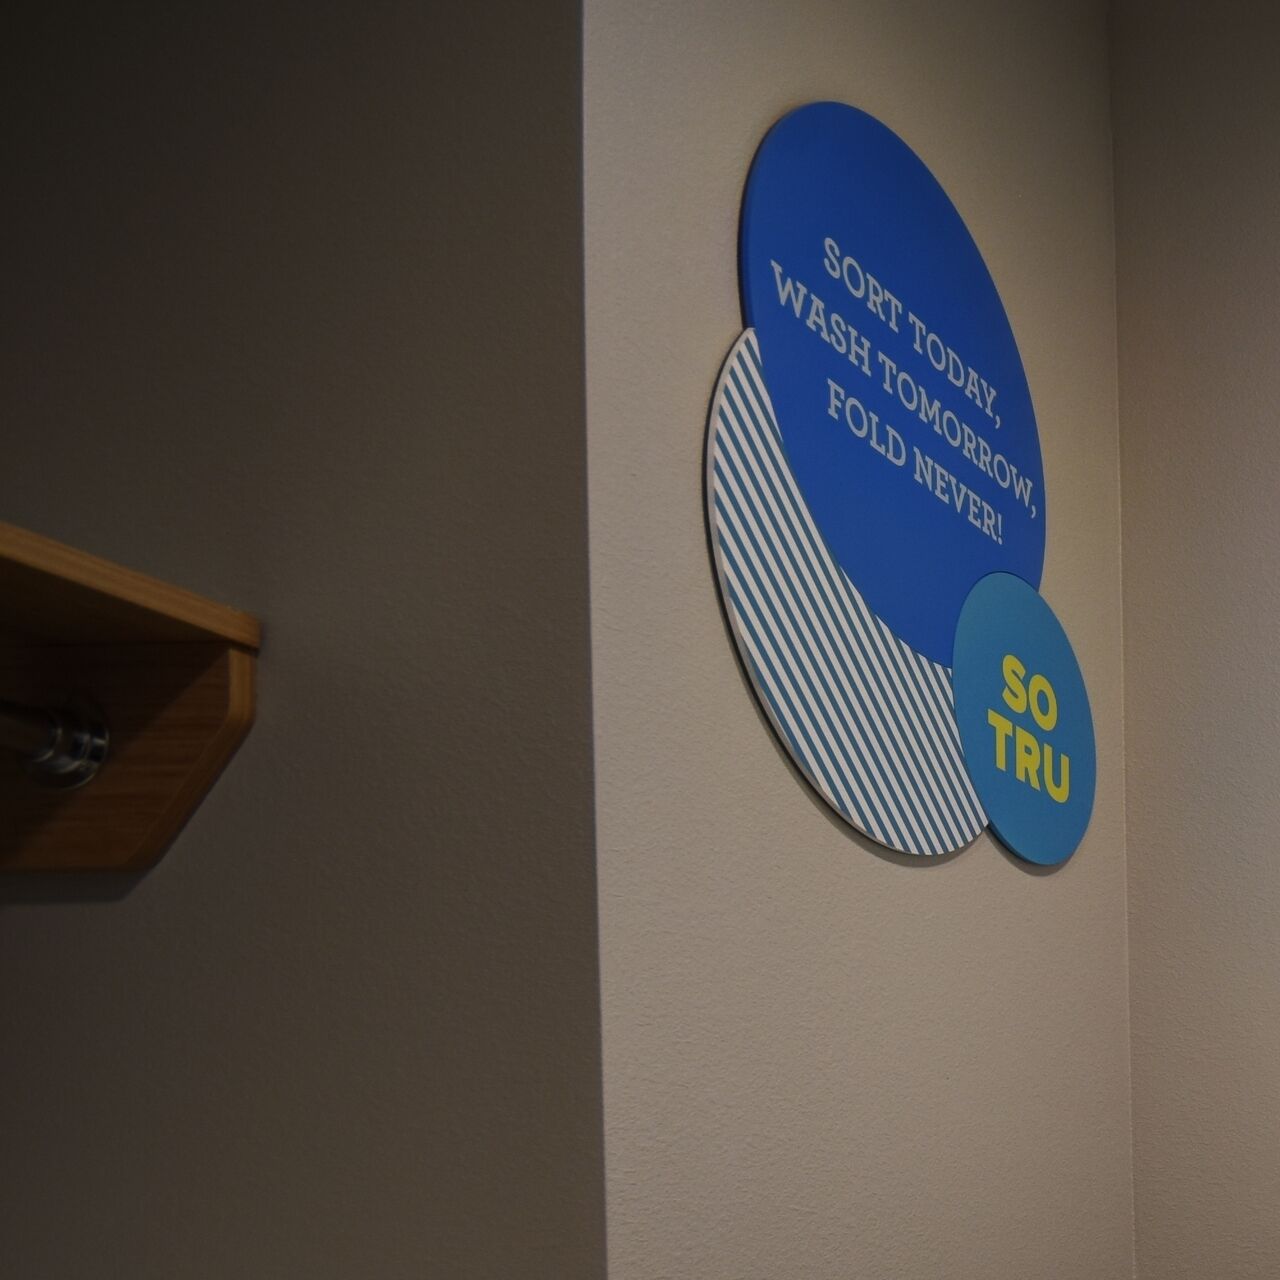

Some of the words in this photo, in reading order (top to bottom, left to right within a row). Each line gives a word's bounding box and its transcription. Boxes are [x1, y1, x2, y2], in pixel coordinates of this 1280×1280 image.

[770, 260, 872, 377] WASH
[878, 349, 1038, 520] TOMORROW,
[823, 236, 903, 333] SORT
[908, 314, 1003, 429] TODAY,
[827, 378, 907, 469] FOLD
[912, 444, 1005, 547] NEVER!
[987, 708, 1071, 805] TRU
[1001, 652, 1059, 731] SO
